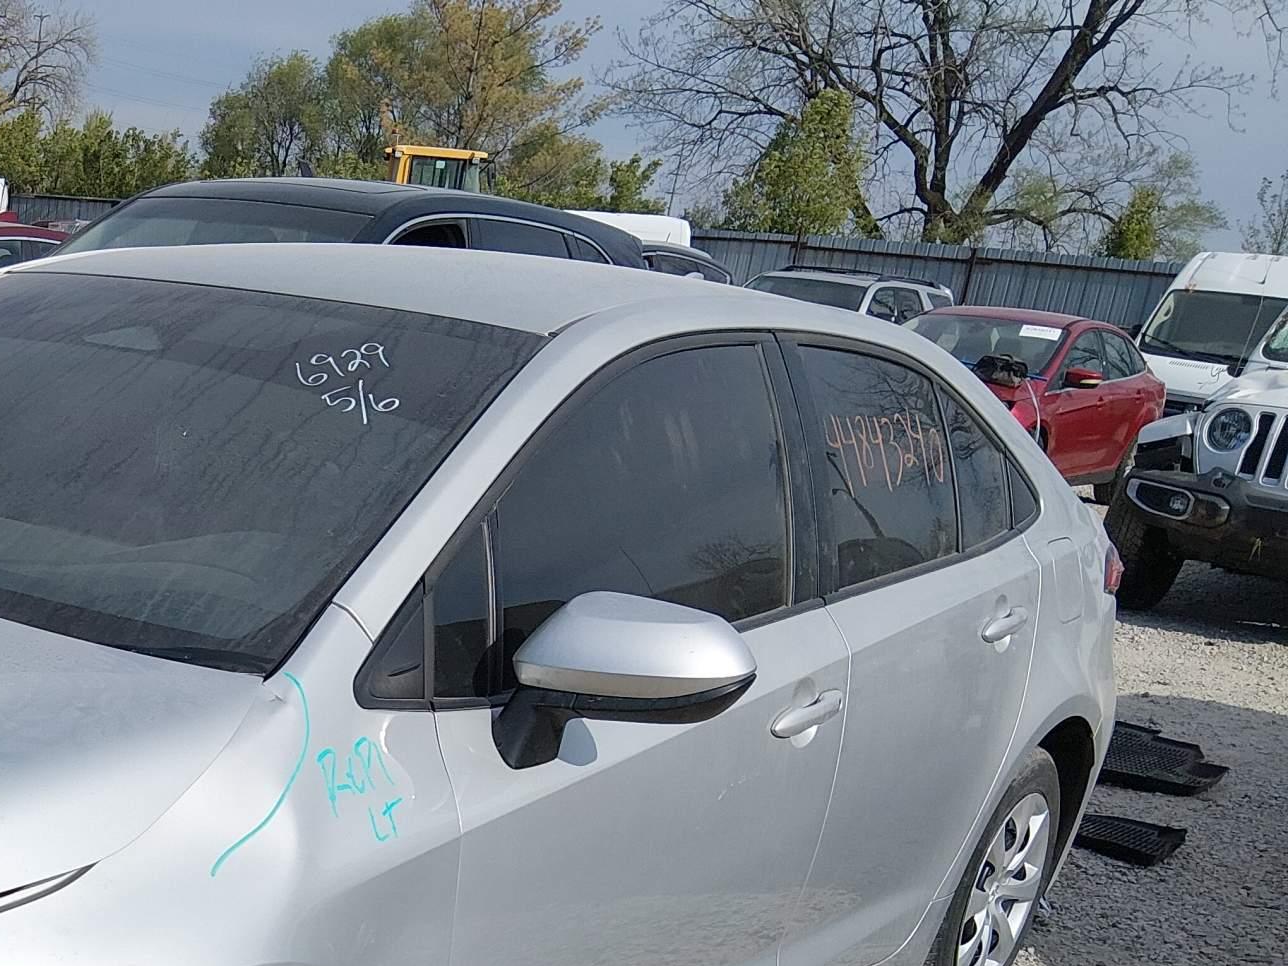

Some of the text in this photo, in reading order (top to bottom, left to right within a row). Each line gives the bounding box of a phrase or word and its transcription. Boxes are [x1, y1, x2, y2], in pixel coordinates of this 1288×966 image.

[295, 341, 391, 387] 6929
[320, 377, 401, 425] 5/6
[823, 407, 944, 497] 44843240
